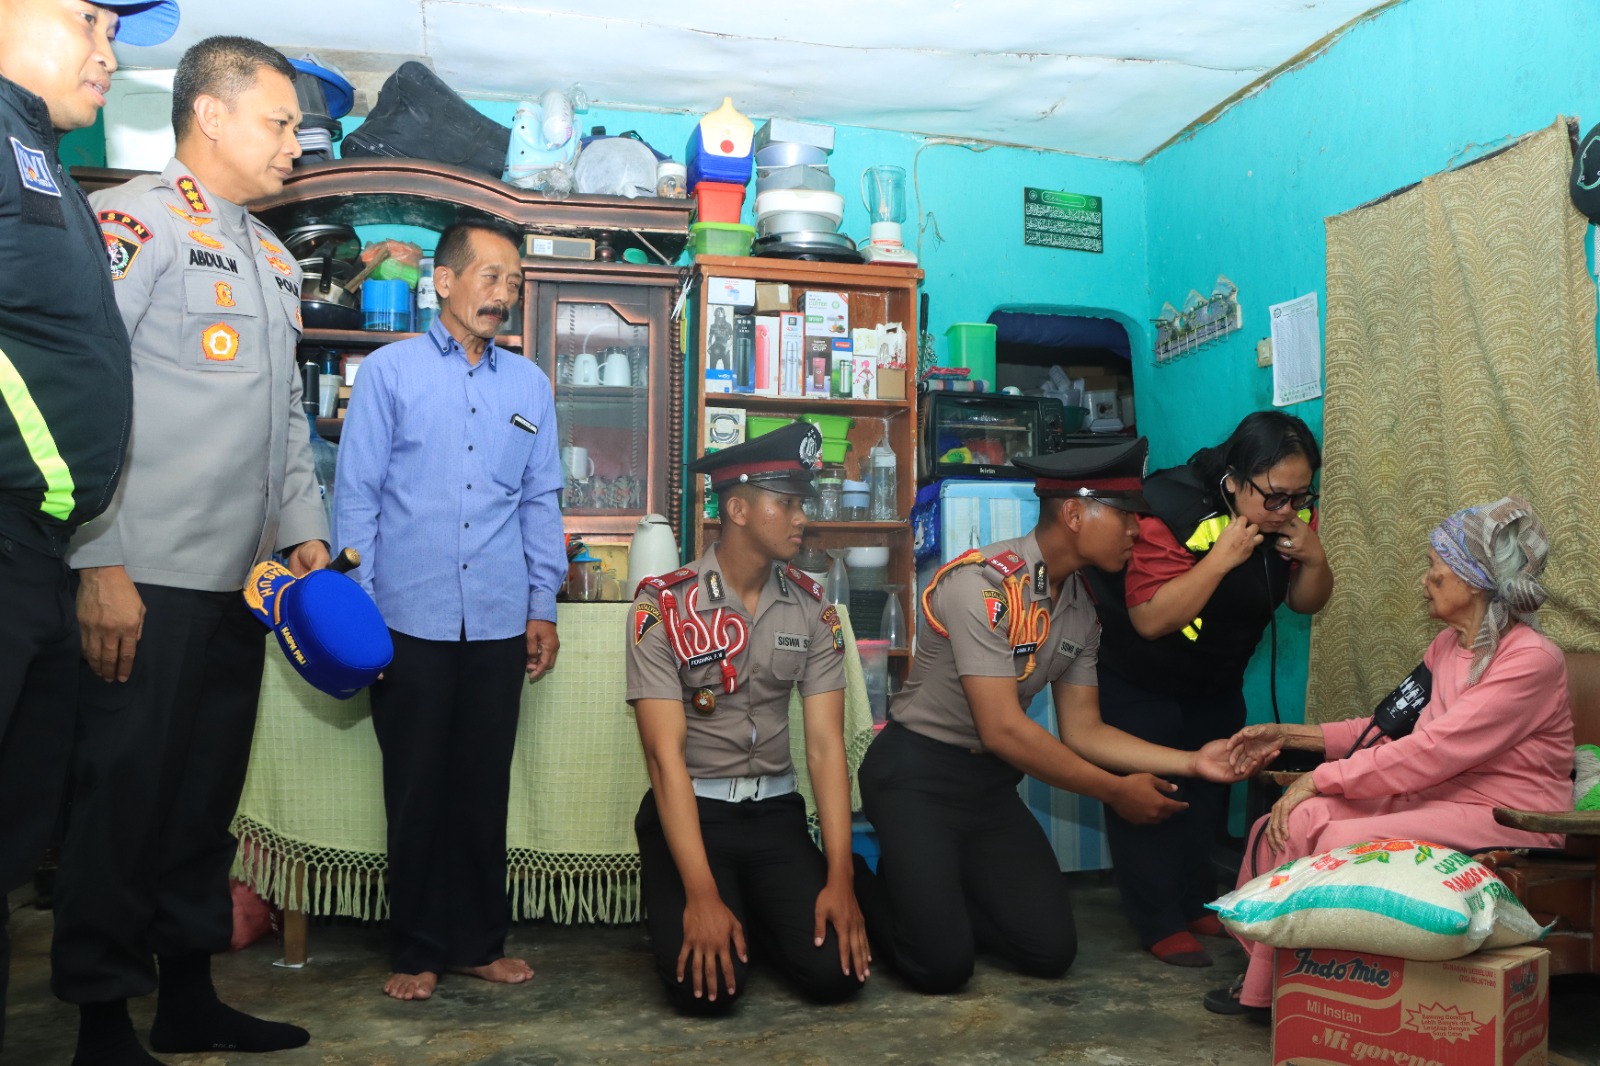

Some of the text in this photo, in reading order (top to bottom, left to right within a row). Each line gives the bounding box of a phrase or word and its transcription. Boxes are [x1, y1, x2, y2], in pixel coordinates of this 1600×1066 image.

[107, 212, 145, 235] SPN
[189, 249, 239, 274] ABDUL.W
[990, 559, 1010, 573] SPN
[777, 636, 801, 648] SISWA
[1306, 999, 1362, 1024] Mi Instan
[1312, 1028, 1446, 1066] Mi goren
